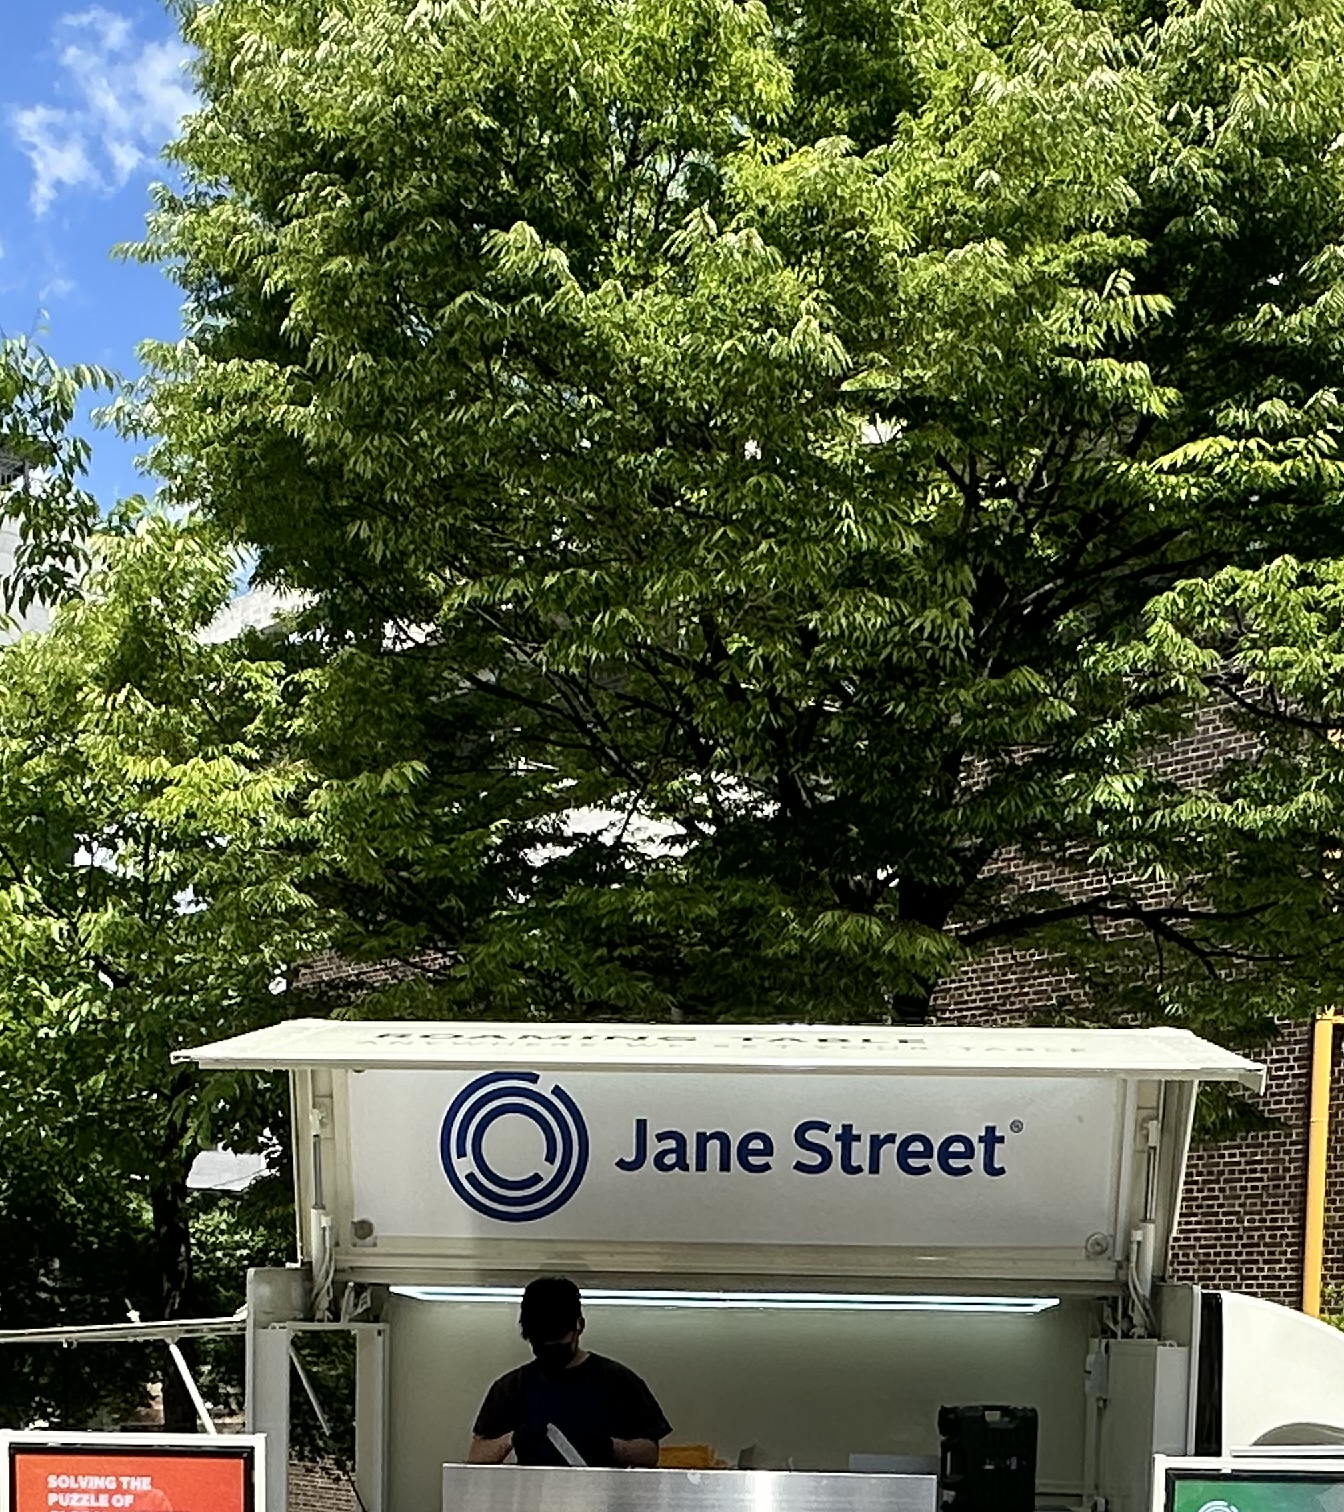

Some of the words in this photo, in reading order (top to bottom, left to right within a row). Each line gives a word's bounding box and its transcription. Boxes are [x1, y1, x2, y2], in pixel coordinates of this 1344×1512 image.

[375, 1032, 698, 1042] ROAMING
[729, 1036, 926, 1044] TABLE
[614, 1118, 775, 1174] Jane
[47, 1475, 117, 1490] SOLVING
[119, 1476, 152, 1490] THE
[47, 1493, 109, 1507] PUZZLE
[111, 1494, 134, 1507] OF
